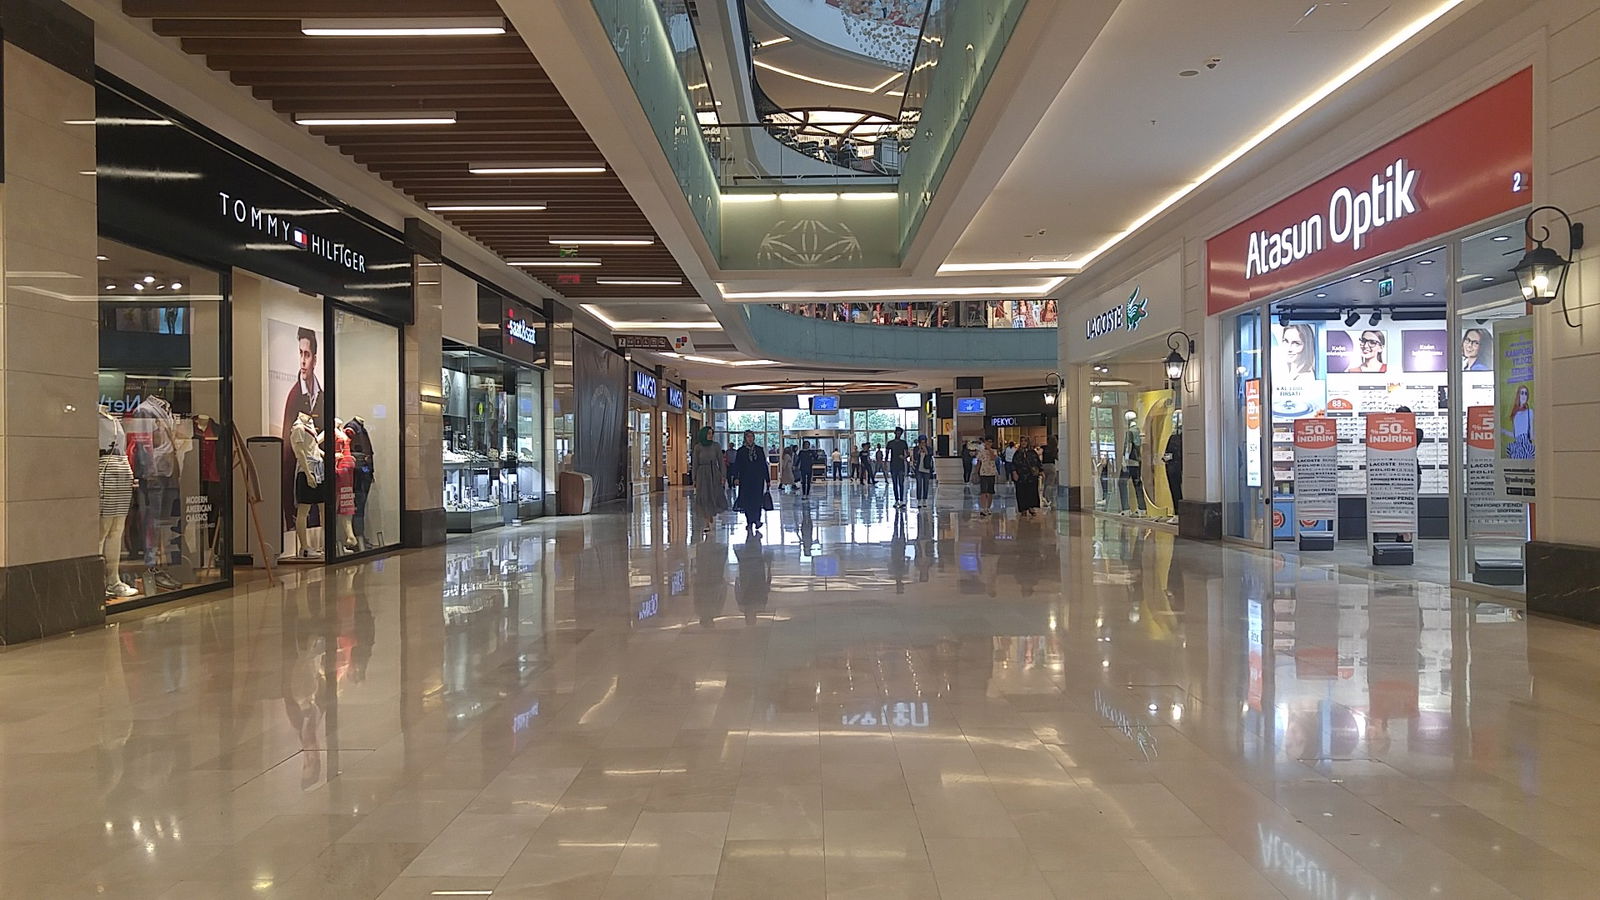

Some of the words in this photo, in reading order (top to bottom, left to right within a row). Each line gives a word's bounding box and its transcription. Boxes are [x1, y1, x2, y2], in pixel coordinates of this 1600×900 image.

[1245, 214, 1322, 279] Atasun
[1329, 158, 1416, 250] Optik
[219, 191, 292, 241] TOMMY
[311, 233, 367, 274] HILFIGER
[1086, 304, 1124, 340] LACOSTE
[636, 371, 657, 399] MANGO
[669, 385, 684, 409] MANGO
[1297, 434, 1334, 443] İNDİRİM
[1369, 433, 1412, 443] İNDİRİM
[186, 495, 208, 504] MODERN
[186, 504, 212, 513] AMERICAN
[186, 513, 208, 522] CLASSICS
